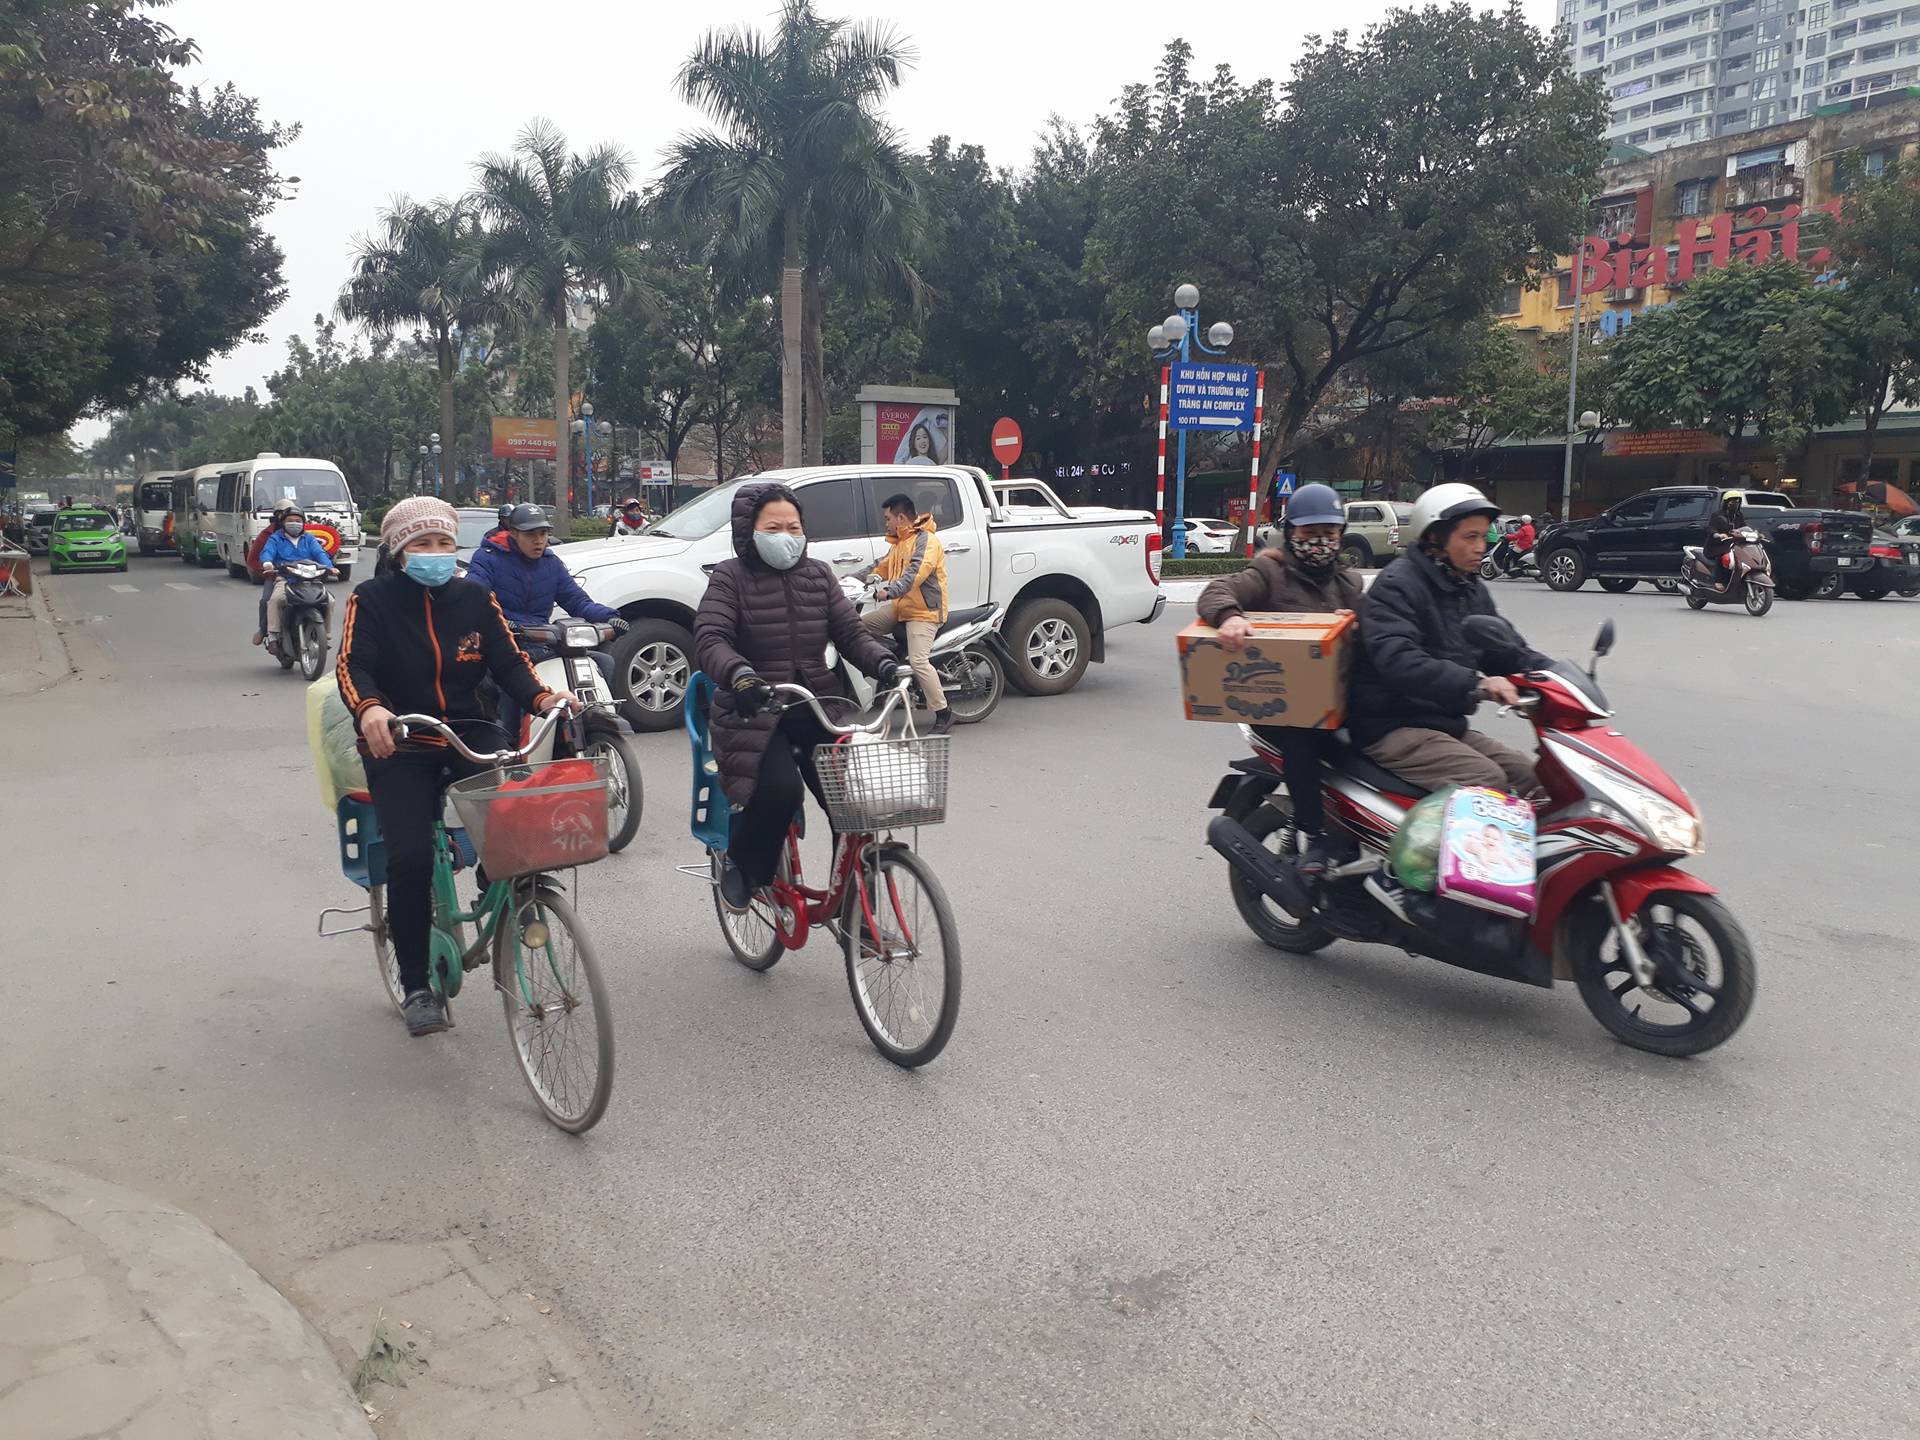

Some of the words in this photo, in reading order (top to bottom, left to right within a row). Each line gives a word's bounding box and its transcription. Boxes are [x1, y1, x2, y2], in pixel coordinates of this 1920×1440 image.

[1568, 233, 1669, 296] Bia
[1180, 369, 1195, 380] KHU
[1197, 384, 1207, 395] VÀ
[1235, 387, 1250, 399] HỌC
[1202, 400, 1213, 410] AN
[1213, 400, 1245, 411] COMPLEX
[881, 411, 910, 420] EVERON
[552, 833, 593, 851] AIA
